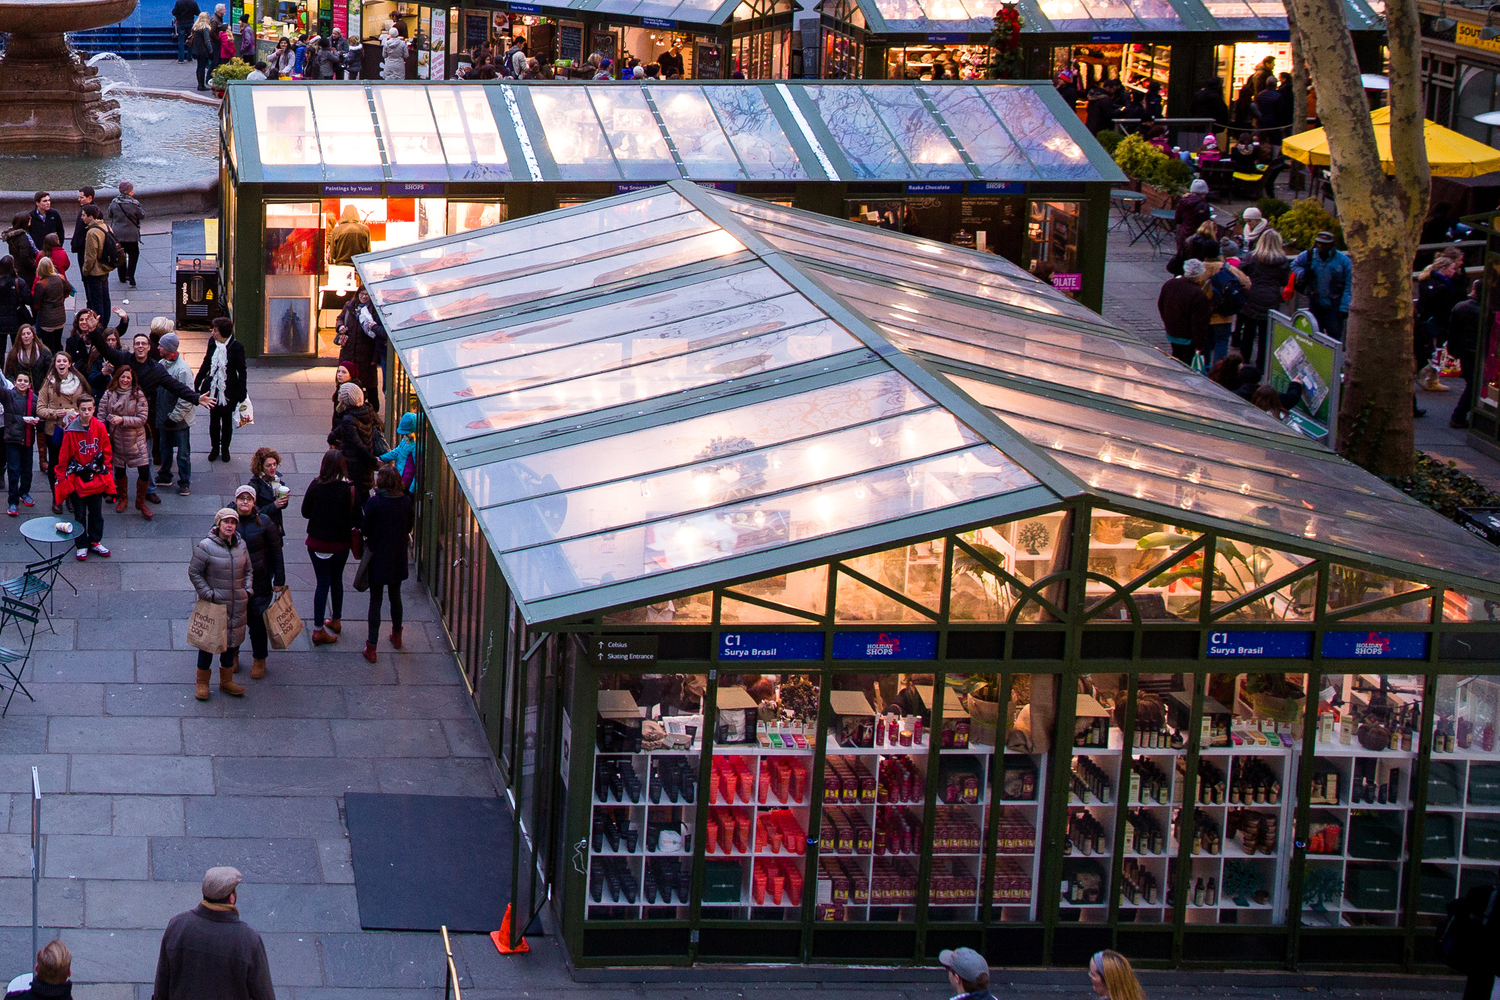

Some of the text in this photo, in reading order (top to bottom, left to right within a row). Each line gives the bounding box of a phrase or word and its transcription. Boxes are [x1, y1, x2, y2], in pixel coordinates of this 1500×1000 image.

[191, 625, 203, 637] bag
[282, 623, 294, 634] bag
[725, 635, 741, 646] C1
[1212, 633, 1228, 644] C1
[725, 648, 777, 657] Surya Brasil
[1210, 646, 1263, 655] Surya Brasil
